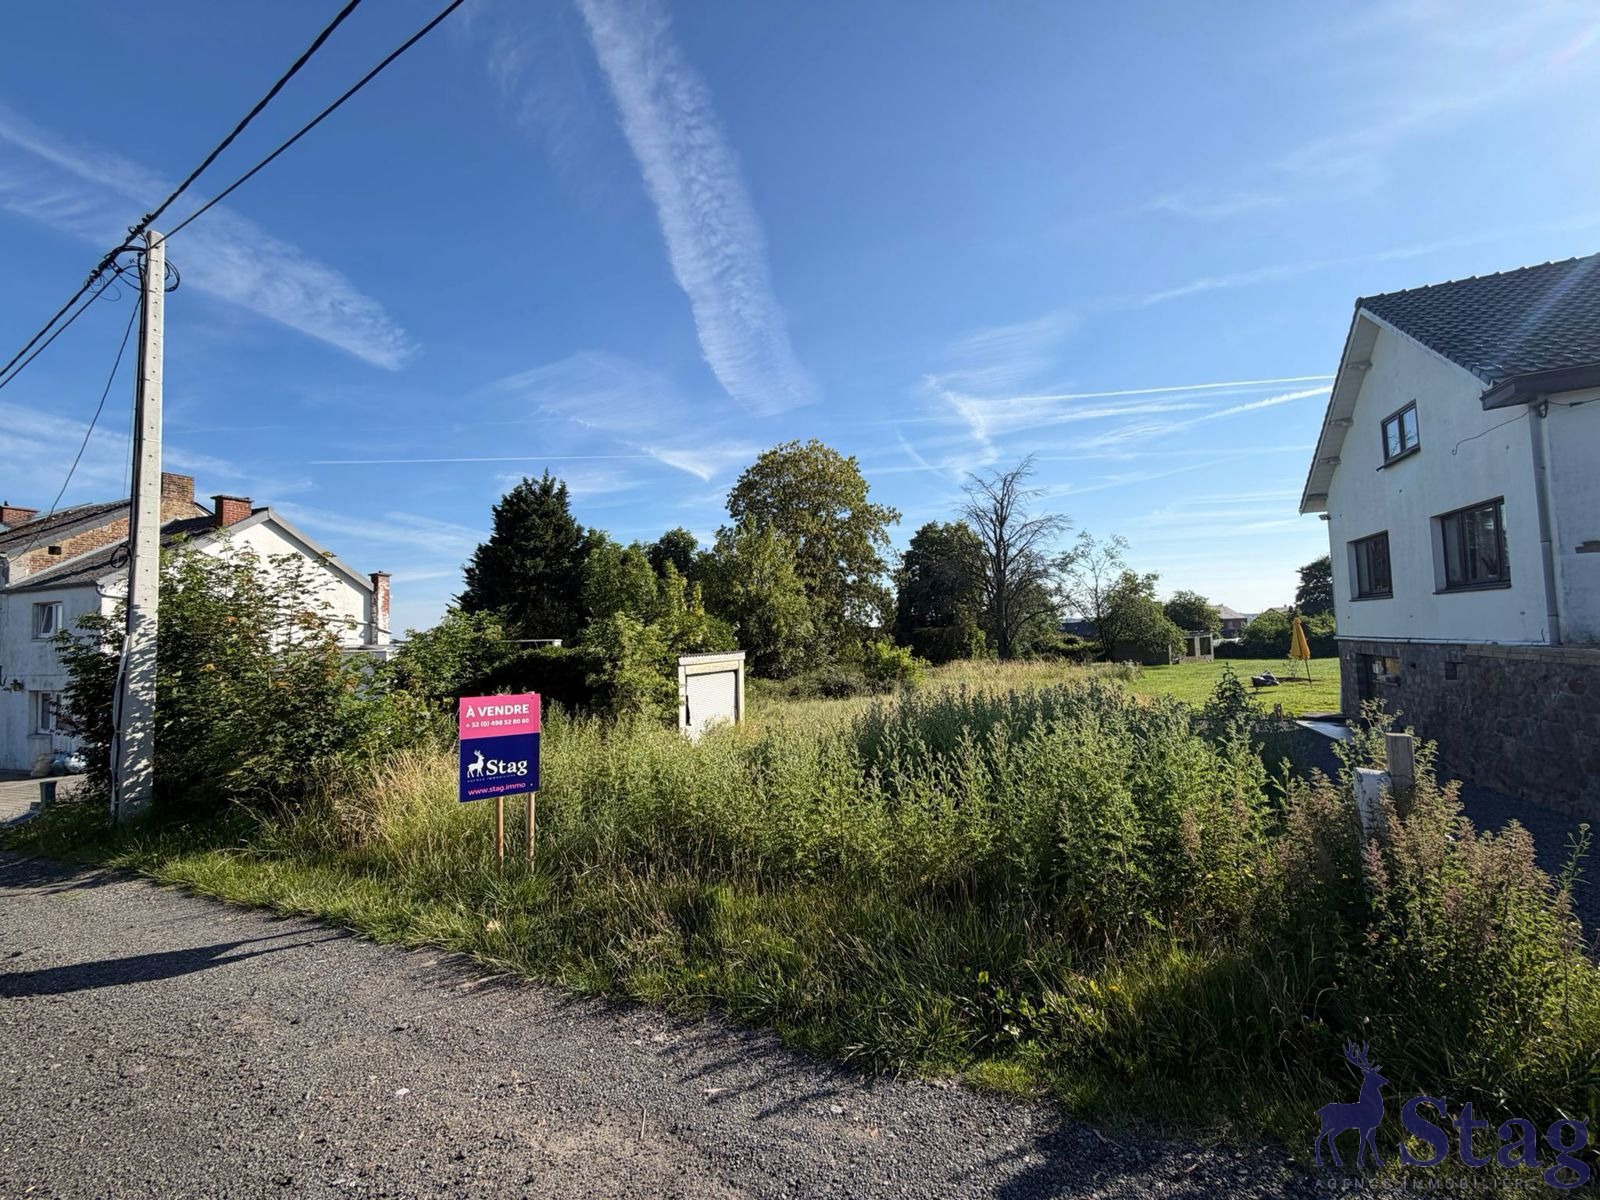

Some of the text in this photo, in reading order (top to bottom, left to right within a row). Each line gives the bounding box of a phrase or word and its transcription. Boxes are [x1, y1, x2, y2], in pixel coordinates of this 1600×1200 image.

[478, 704, 529, 717] VENDRE
[486, 759, 527, 775] Stag
[467, 782, 525, 796] www.stag.immo
